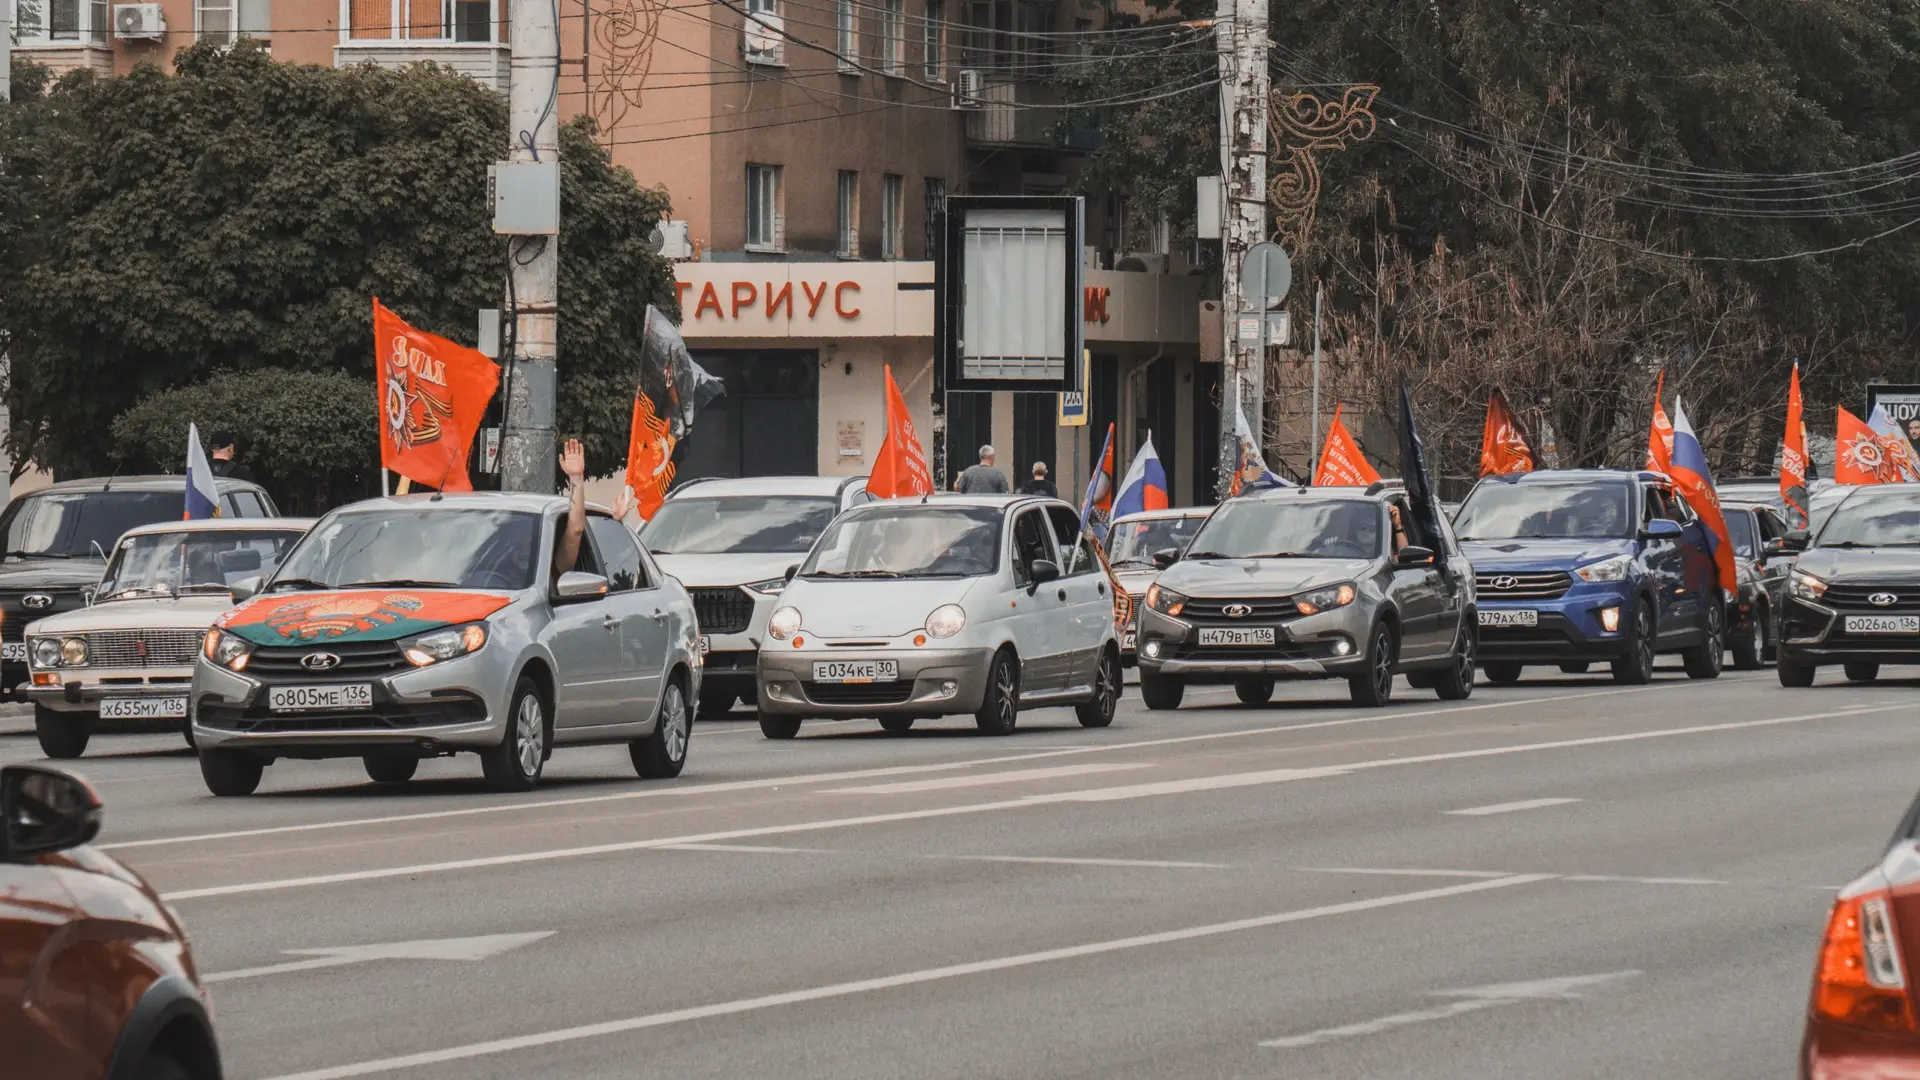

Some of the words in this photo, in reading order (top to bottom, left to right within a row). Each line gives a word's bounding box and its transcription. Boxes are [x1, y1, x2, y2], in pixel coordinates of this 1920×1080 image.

[1478, 612, 1516, 624] 379АХ
[1517, 611, 1535, 620] 136
[1899, 617, 1916, 627] 136
[1202, 630, 1250, 643] Н479ВТ
[1252, 629, 1272, 639] 136
[2, 644, 26, 658] С95
[818, 663, 875, 678] Е034КЕ
[877, 661, 893, 673] 30
[275, 688, 339, 706] О805МЕ
[342, 685, 367, 699] 136
[105, 701, 159, 716] Х655МУ
[162, 699, 183, 711] 136
